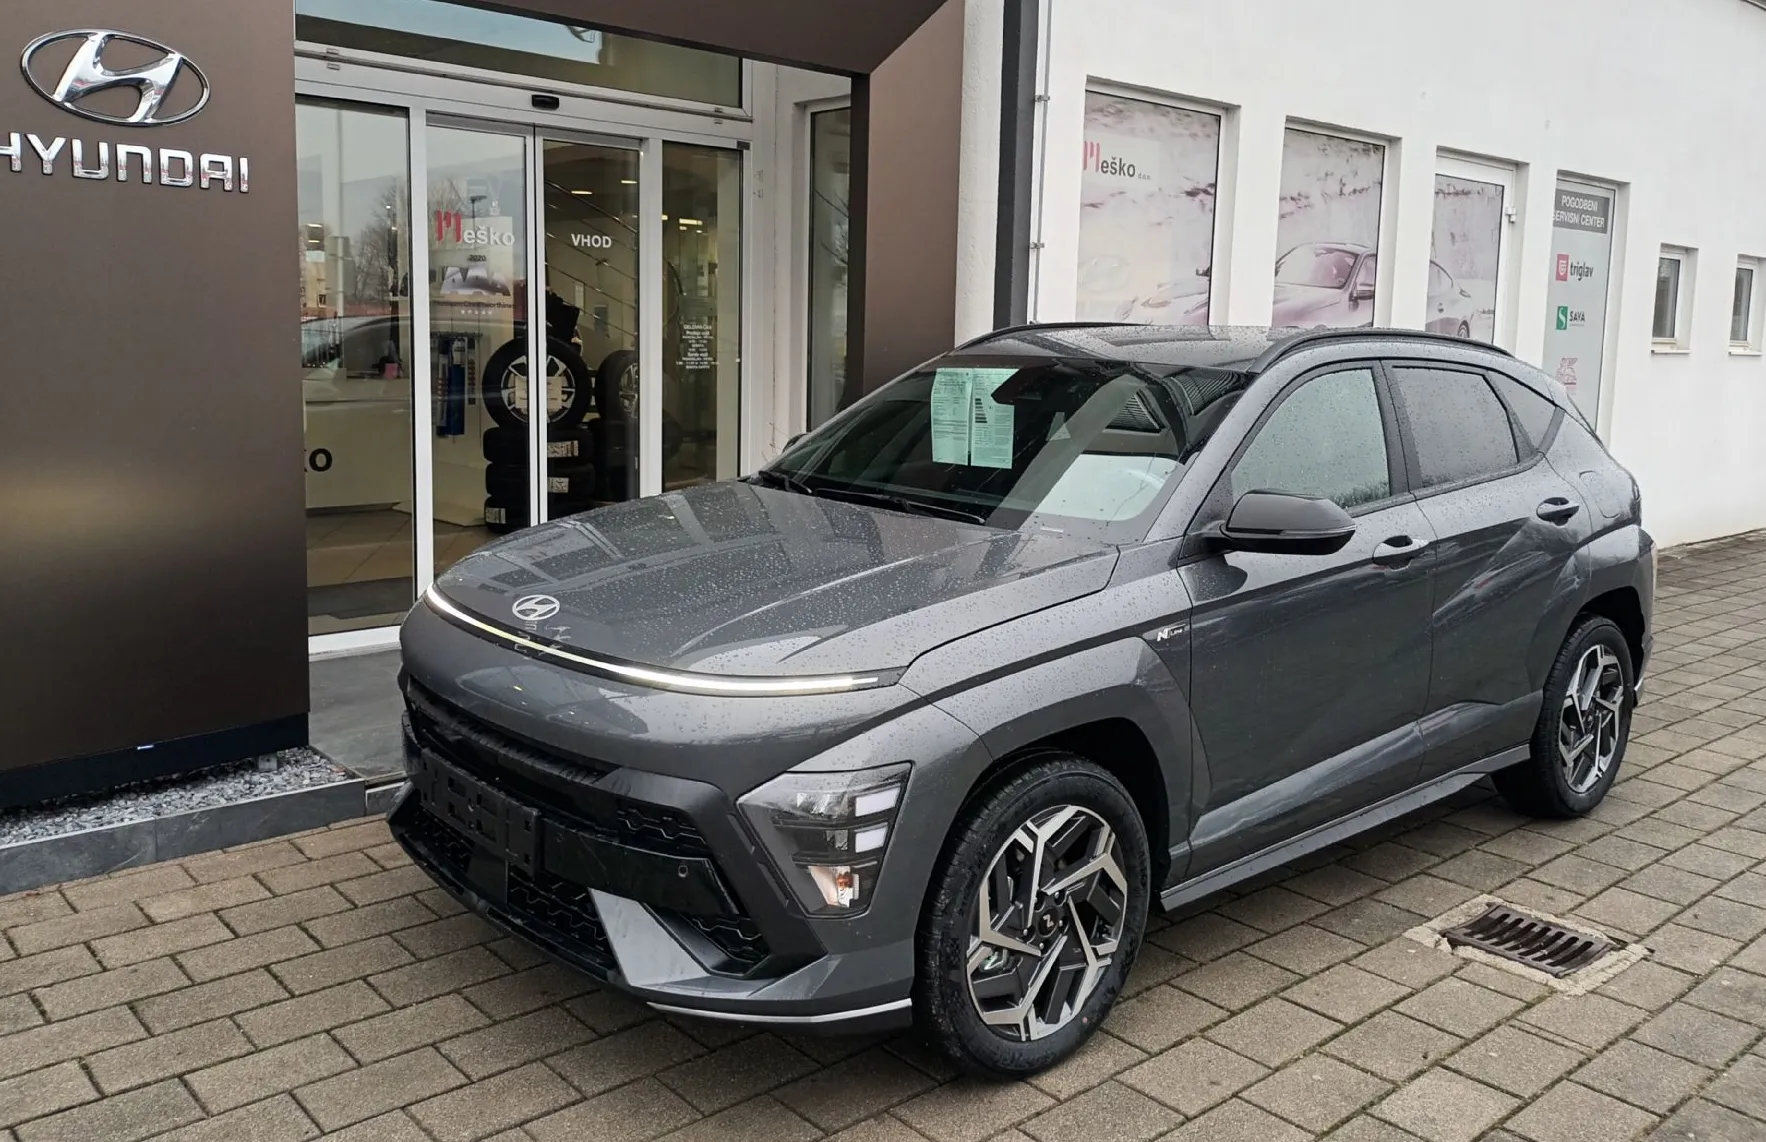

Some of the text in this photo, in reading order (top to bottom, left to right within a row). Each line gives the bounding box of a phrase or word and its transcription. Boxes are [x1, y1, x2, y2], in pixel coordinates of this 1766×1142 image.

[1083, 140, 1136, 178] Meško
[435, 208, 516, 246] Meško
[1580, 214, 1605, 228] CENTER
[570, 233, 612, 249] VHOD
[1570, 261, 1594, 282] triglav
